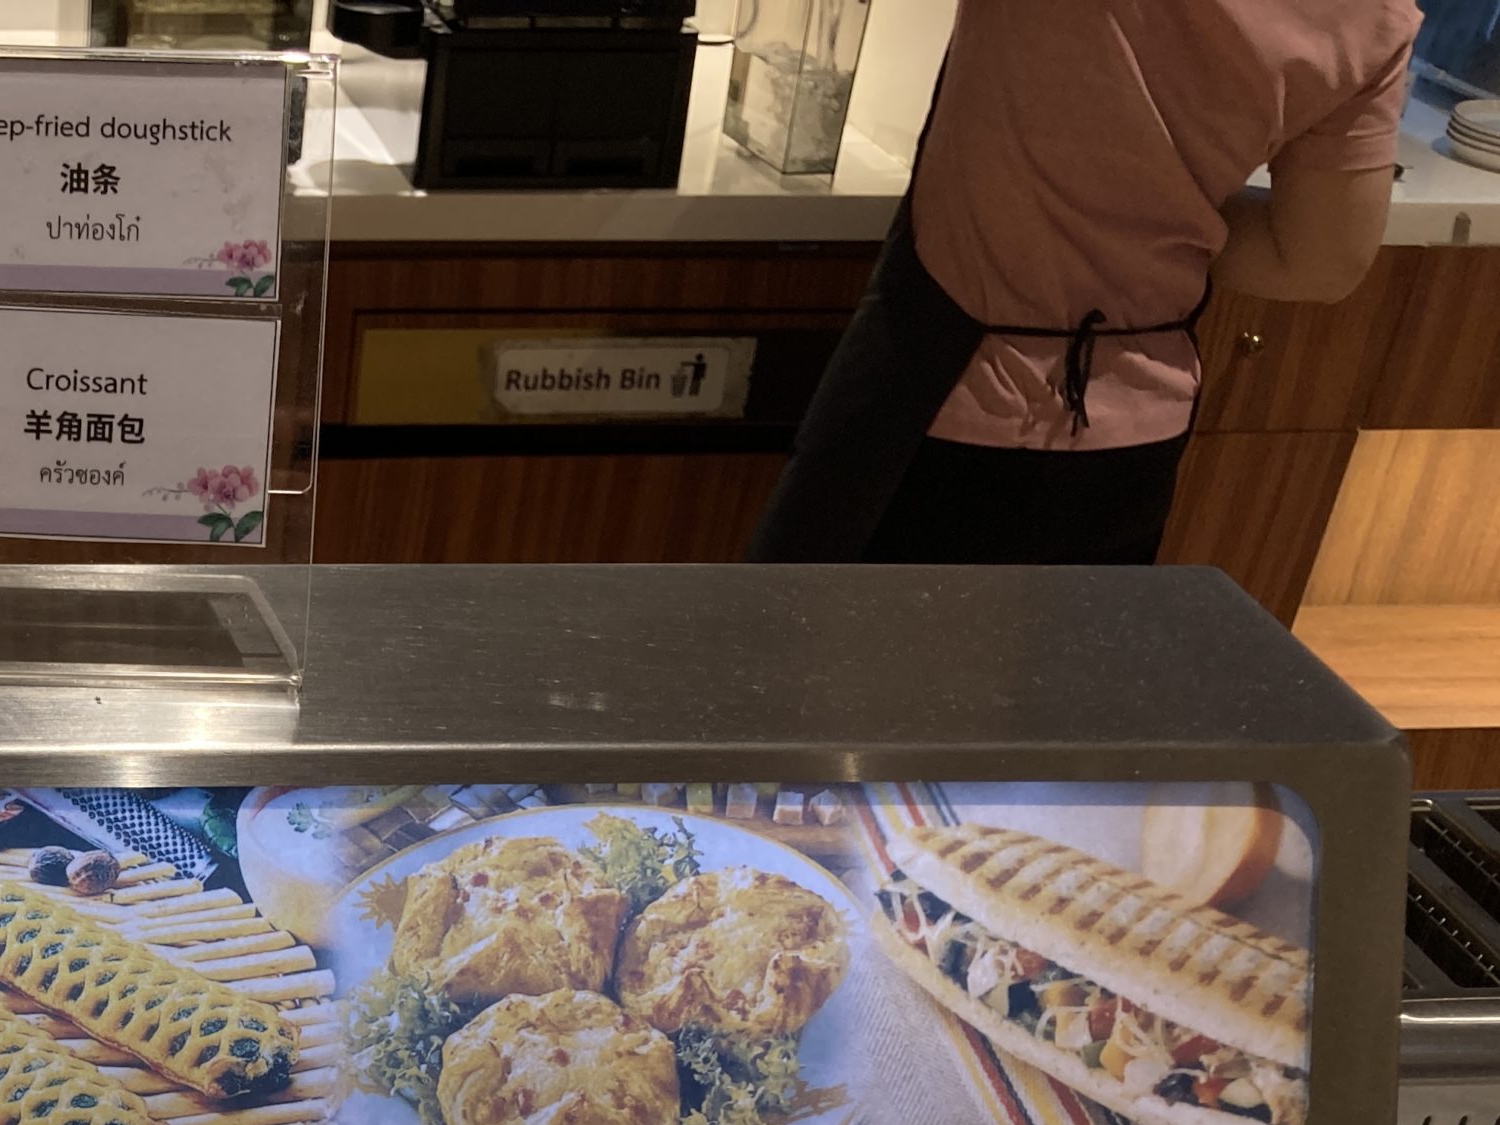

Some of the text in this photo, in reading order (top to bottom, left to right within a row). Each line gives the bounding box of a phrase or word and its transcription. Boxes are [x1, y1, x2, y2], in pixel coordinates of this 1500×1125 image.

[100, 116, 232, 146] doughstick
[60, 162, 121, 195] 油条
[46, 213, 141, 242] ปาท่องโก๋
[26, 367, 148, 396] Croissant
[504, 367, 661, 391] Rubbish Bin
[23, 409, 146, 445] 羊角面包
